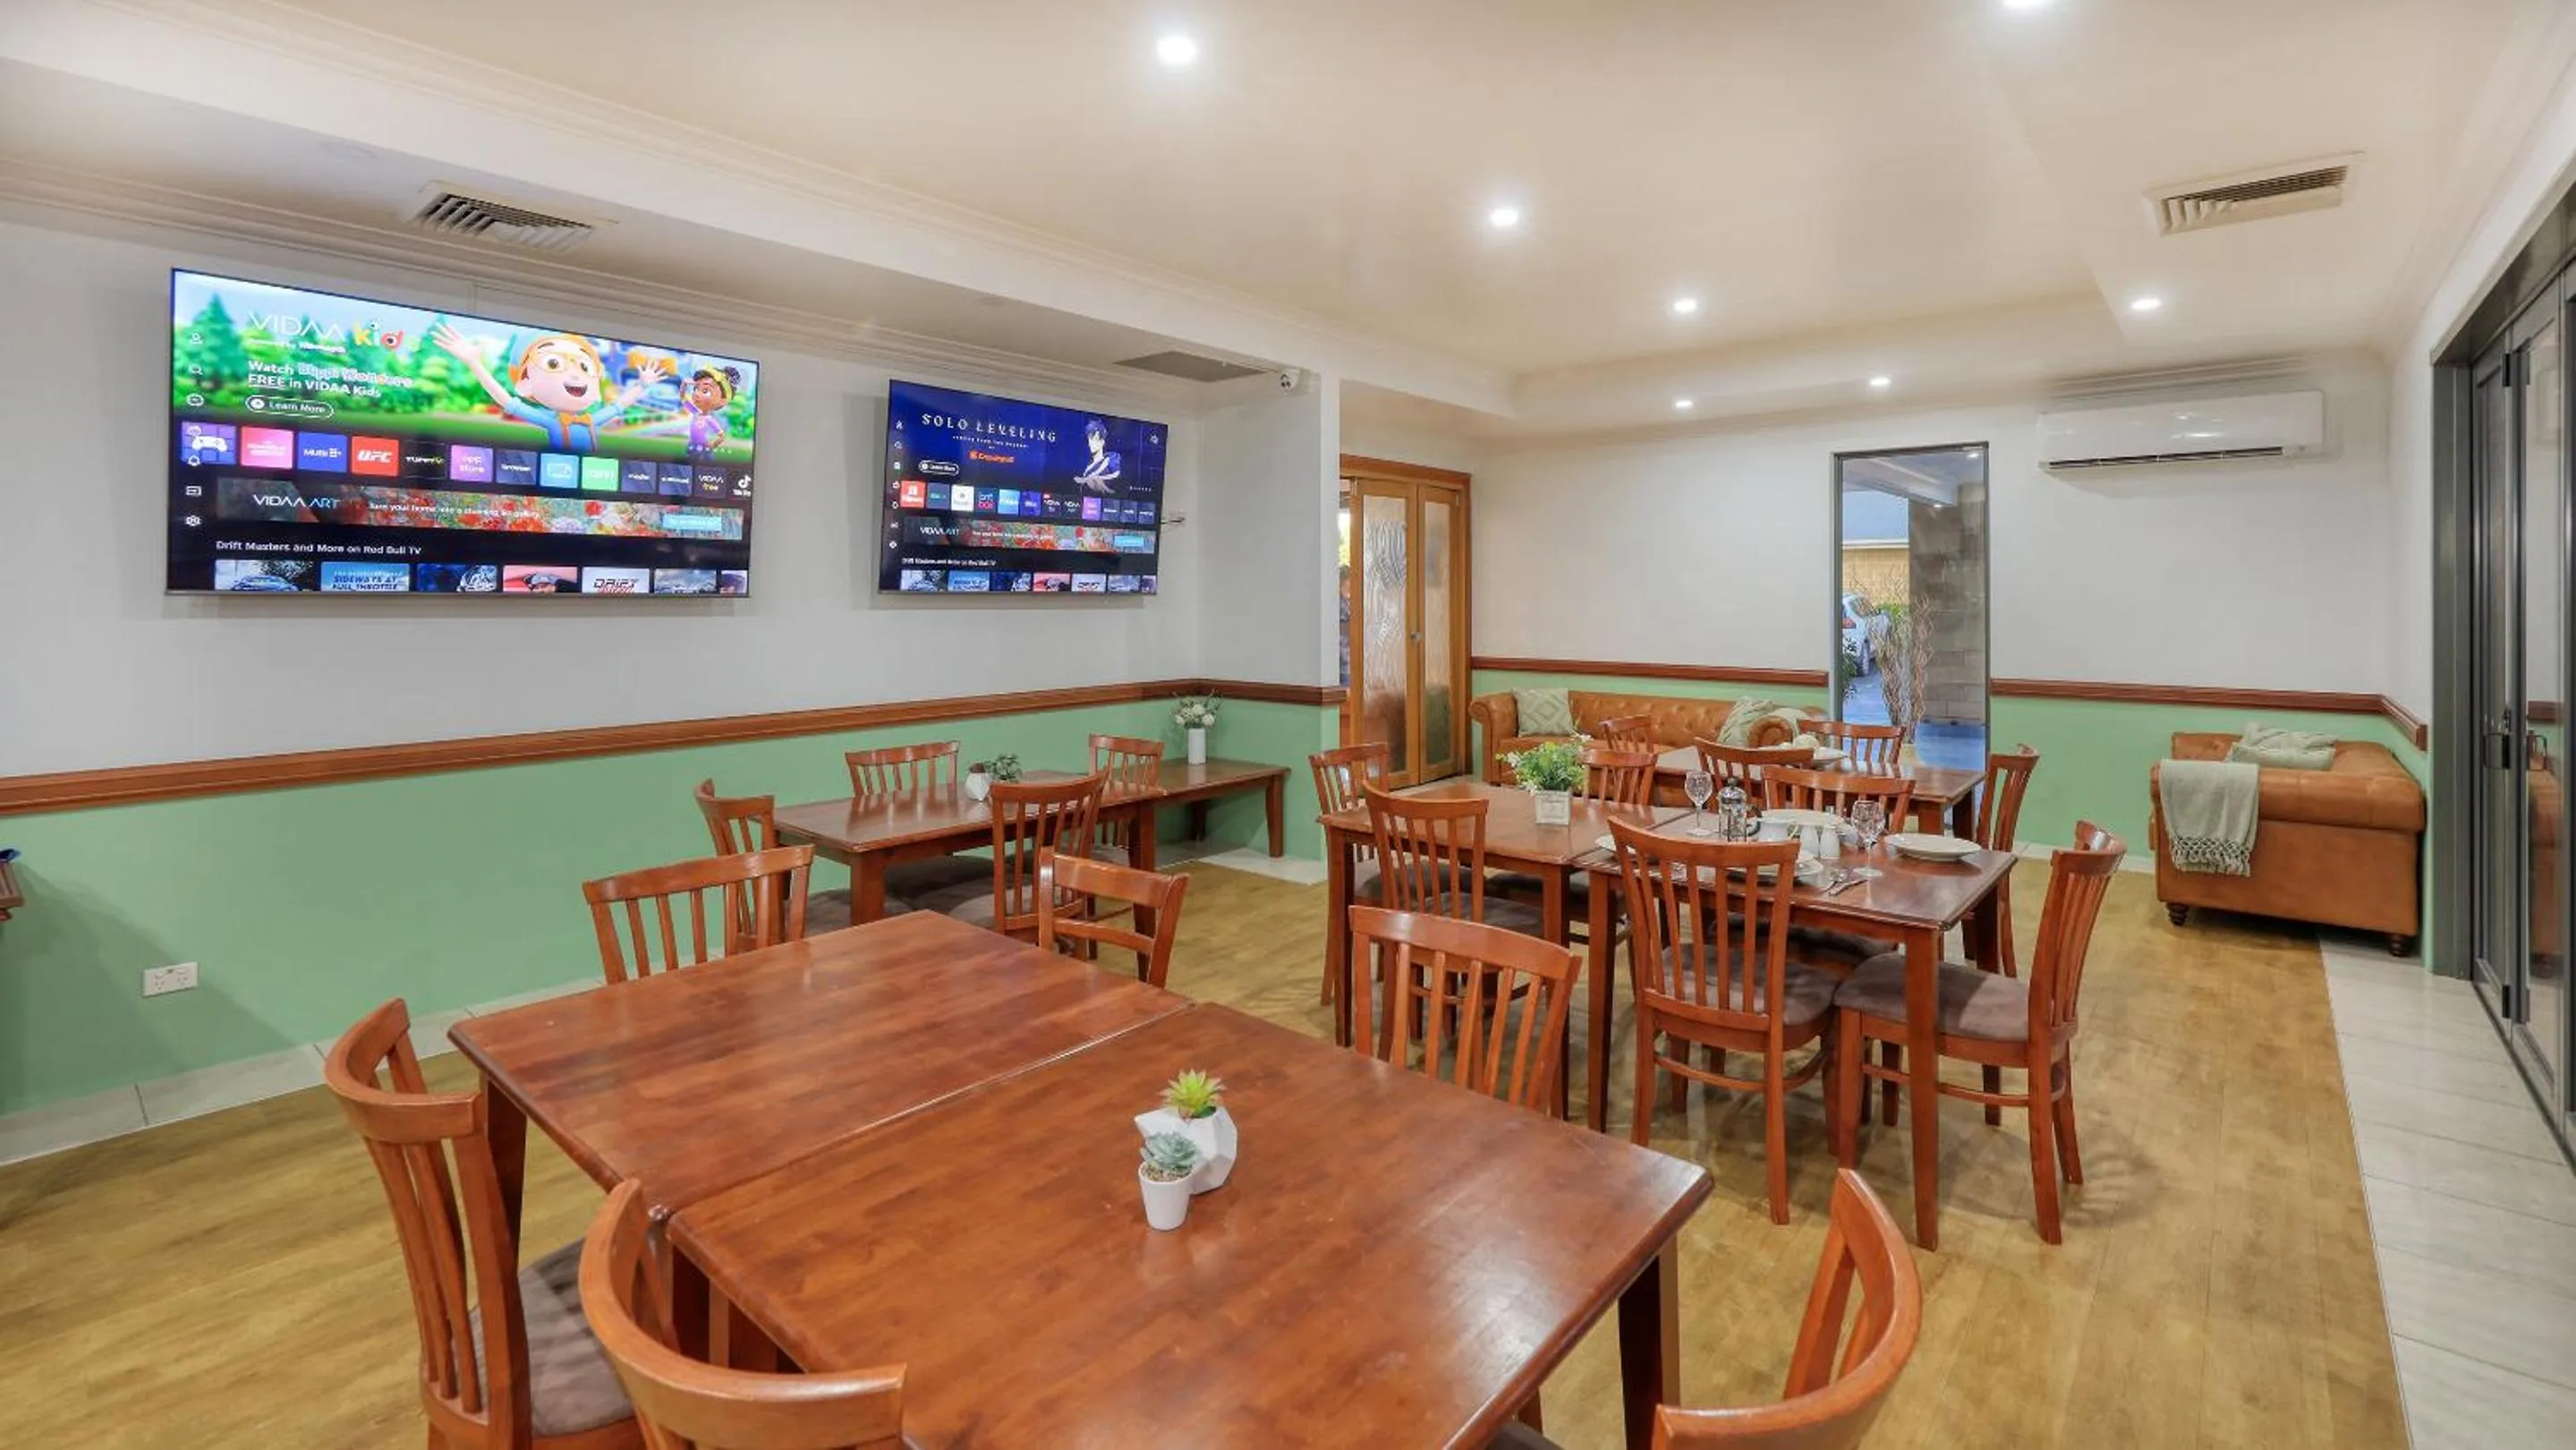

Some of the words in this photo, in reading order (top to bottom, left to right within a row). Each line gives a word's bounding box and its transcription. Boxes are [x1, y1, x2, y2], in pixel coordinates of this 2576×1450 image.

[248, 312, 345, 341] VIDAA
[249, 362, 293, 375] Watch
[248, 375, 285, 387] FREE
[289, 378, 302, 388] in
[305, 380, 351, 396] VIDAA
[353, 386, 381, 398] Kids
[268, 403, 298, 411] Learn
[300, 405, 326, 414] More
[922, 414, 968, 431] SOLO
[976, 421, 1057, 443] LEVELING
[357, 450, 394, 464] UFC
[253, 493, 306, 508] VIDAA
[309, 497, 340, 510] ART
[216, 541, 242, 550] Drift
[293, 543, 313, 552] and
[317, 544, 344, 553] More
[363, 545, 384, 554] Red
[409, 547, 422, 555] TV
